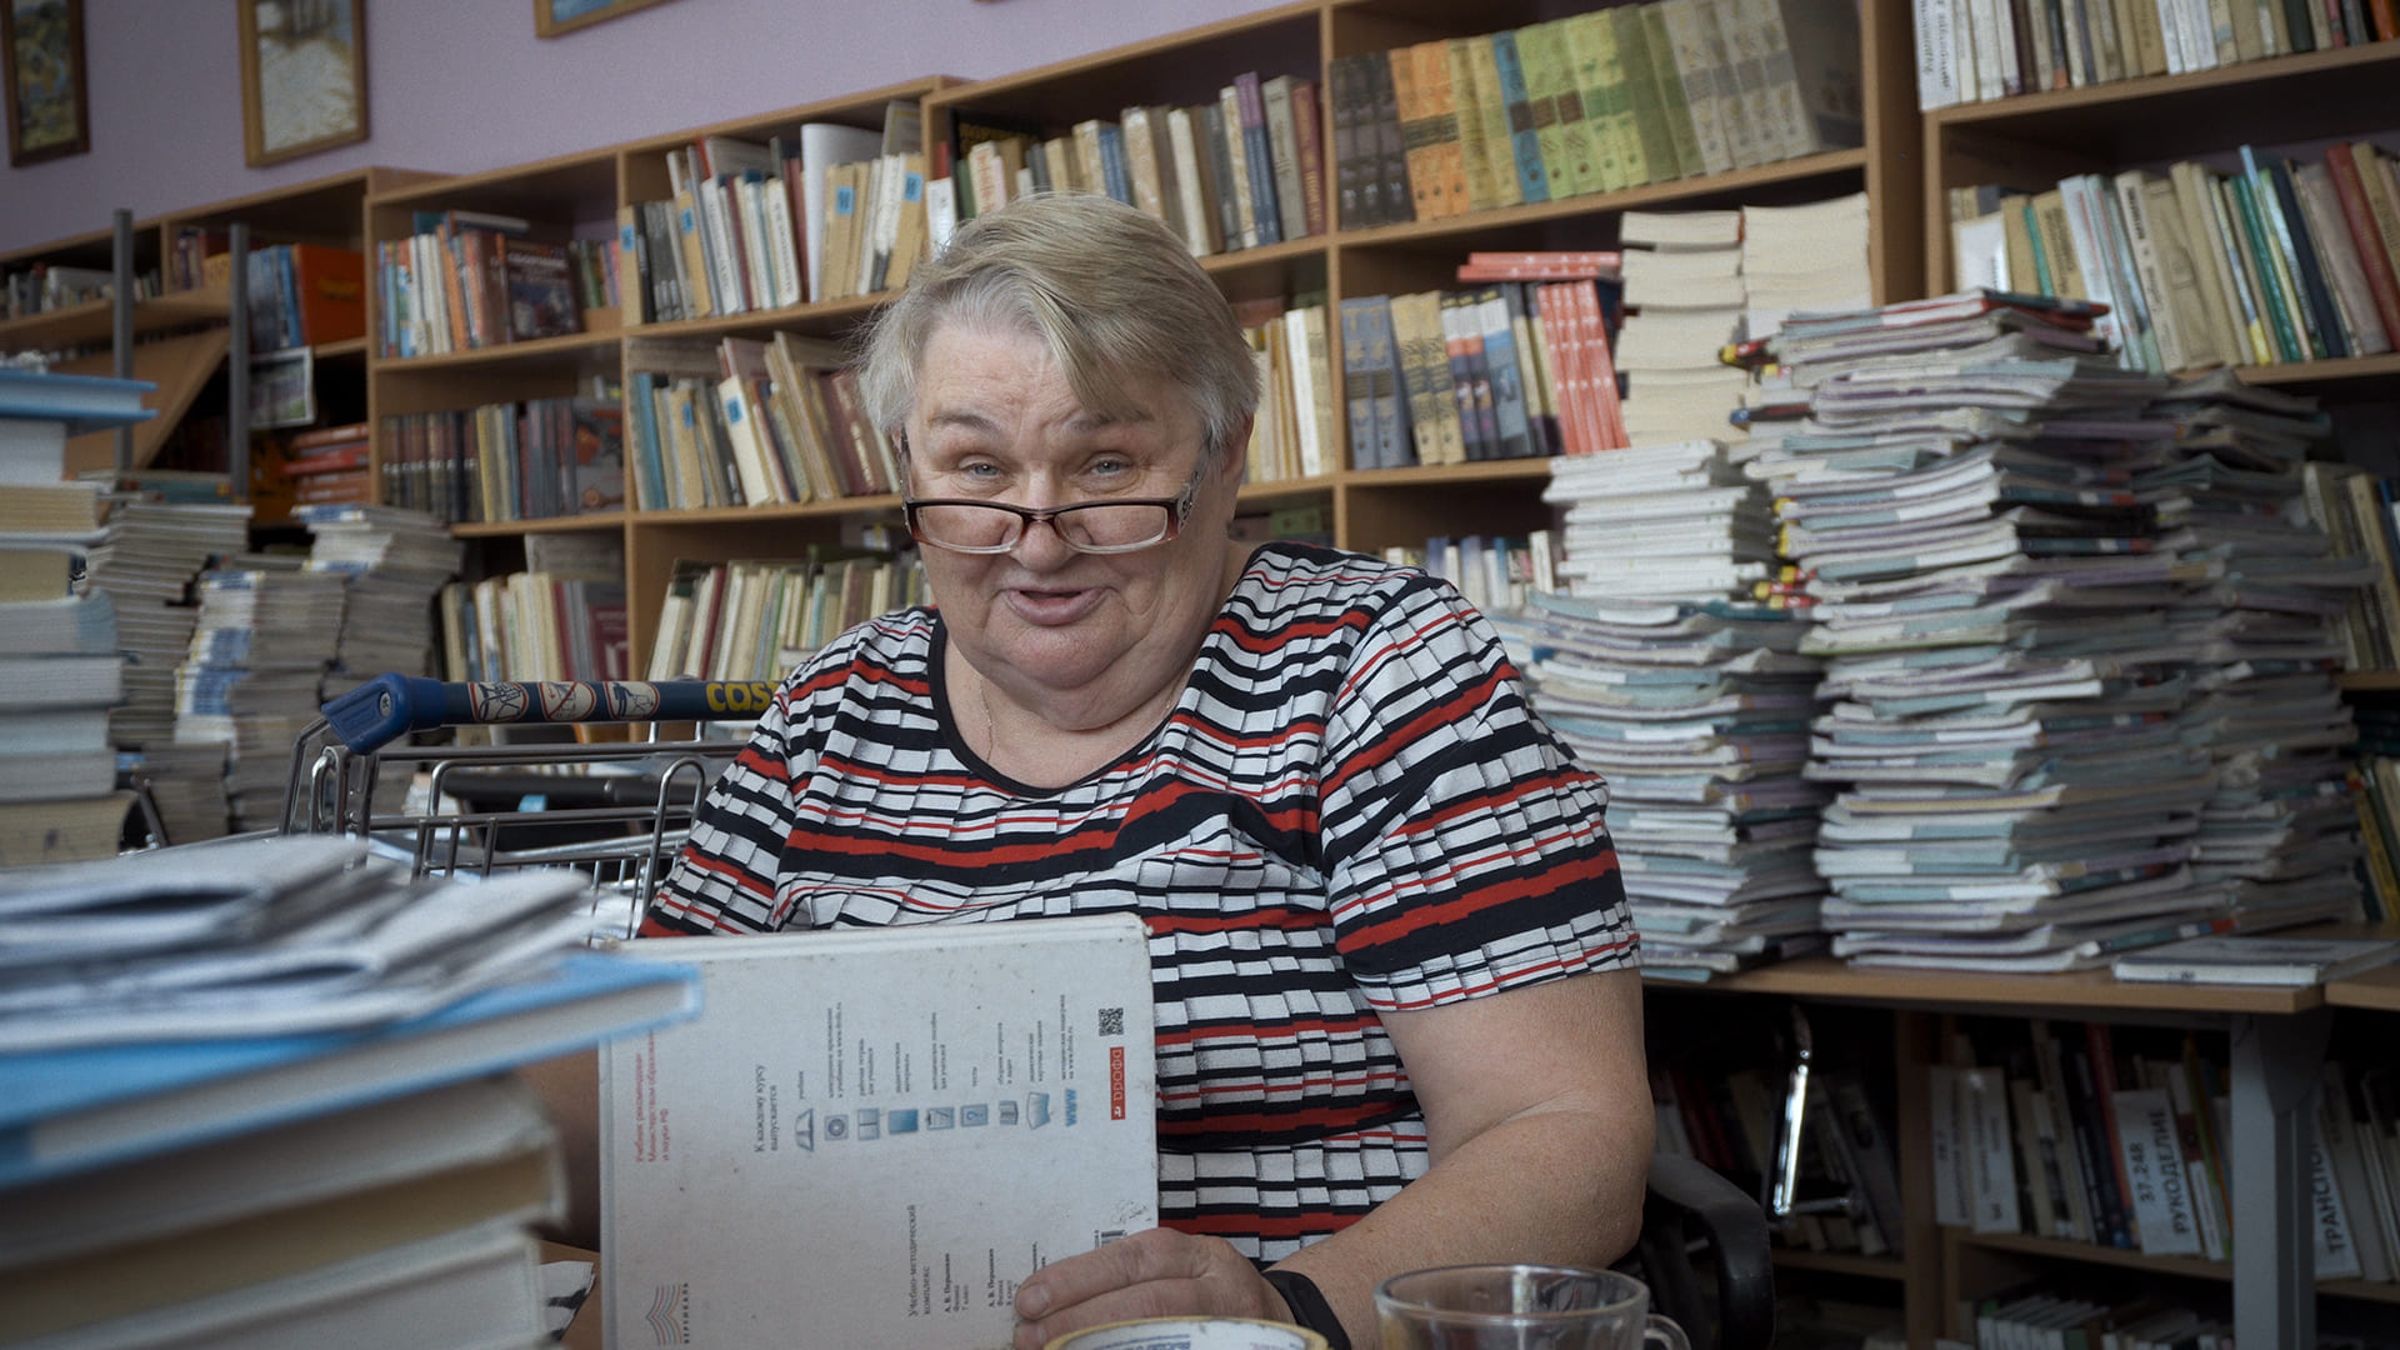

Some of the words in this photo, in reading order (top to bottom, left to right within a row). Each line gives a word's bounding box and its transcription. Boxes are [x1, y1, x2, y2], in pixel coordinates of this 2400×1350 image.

[755, 1065, 766, 1094] курсу
[659, 1108, 669, 1123] РФ
[755, 1096, 766, 1142] каждому
[769, 1085, 780, 1152] выпускается
[754, 1143, 765, 1153] К
[2148, 1110, 2190, 1234] РУКОДЕЛИЕ
[906, 1205, 918, 1317] Учебно-методический
[923, 1266, 931, 1315] комплекс
